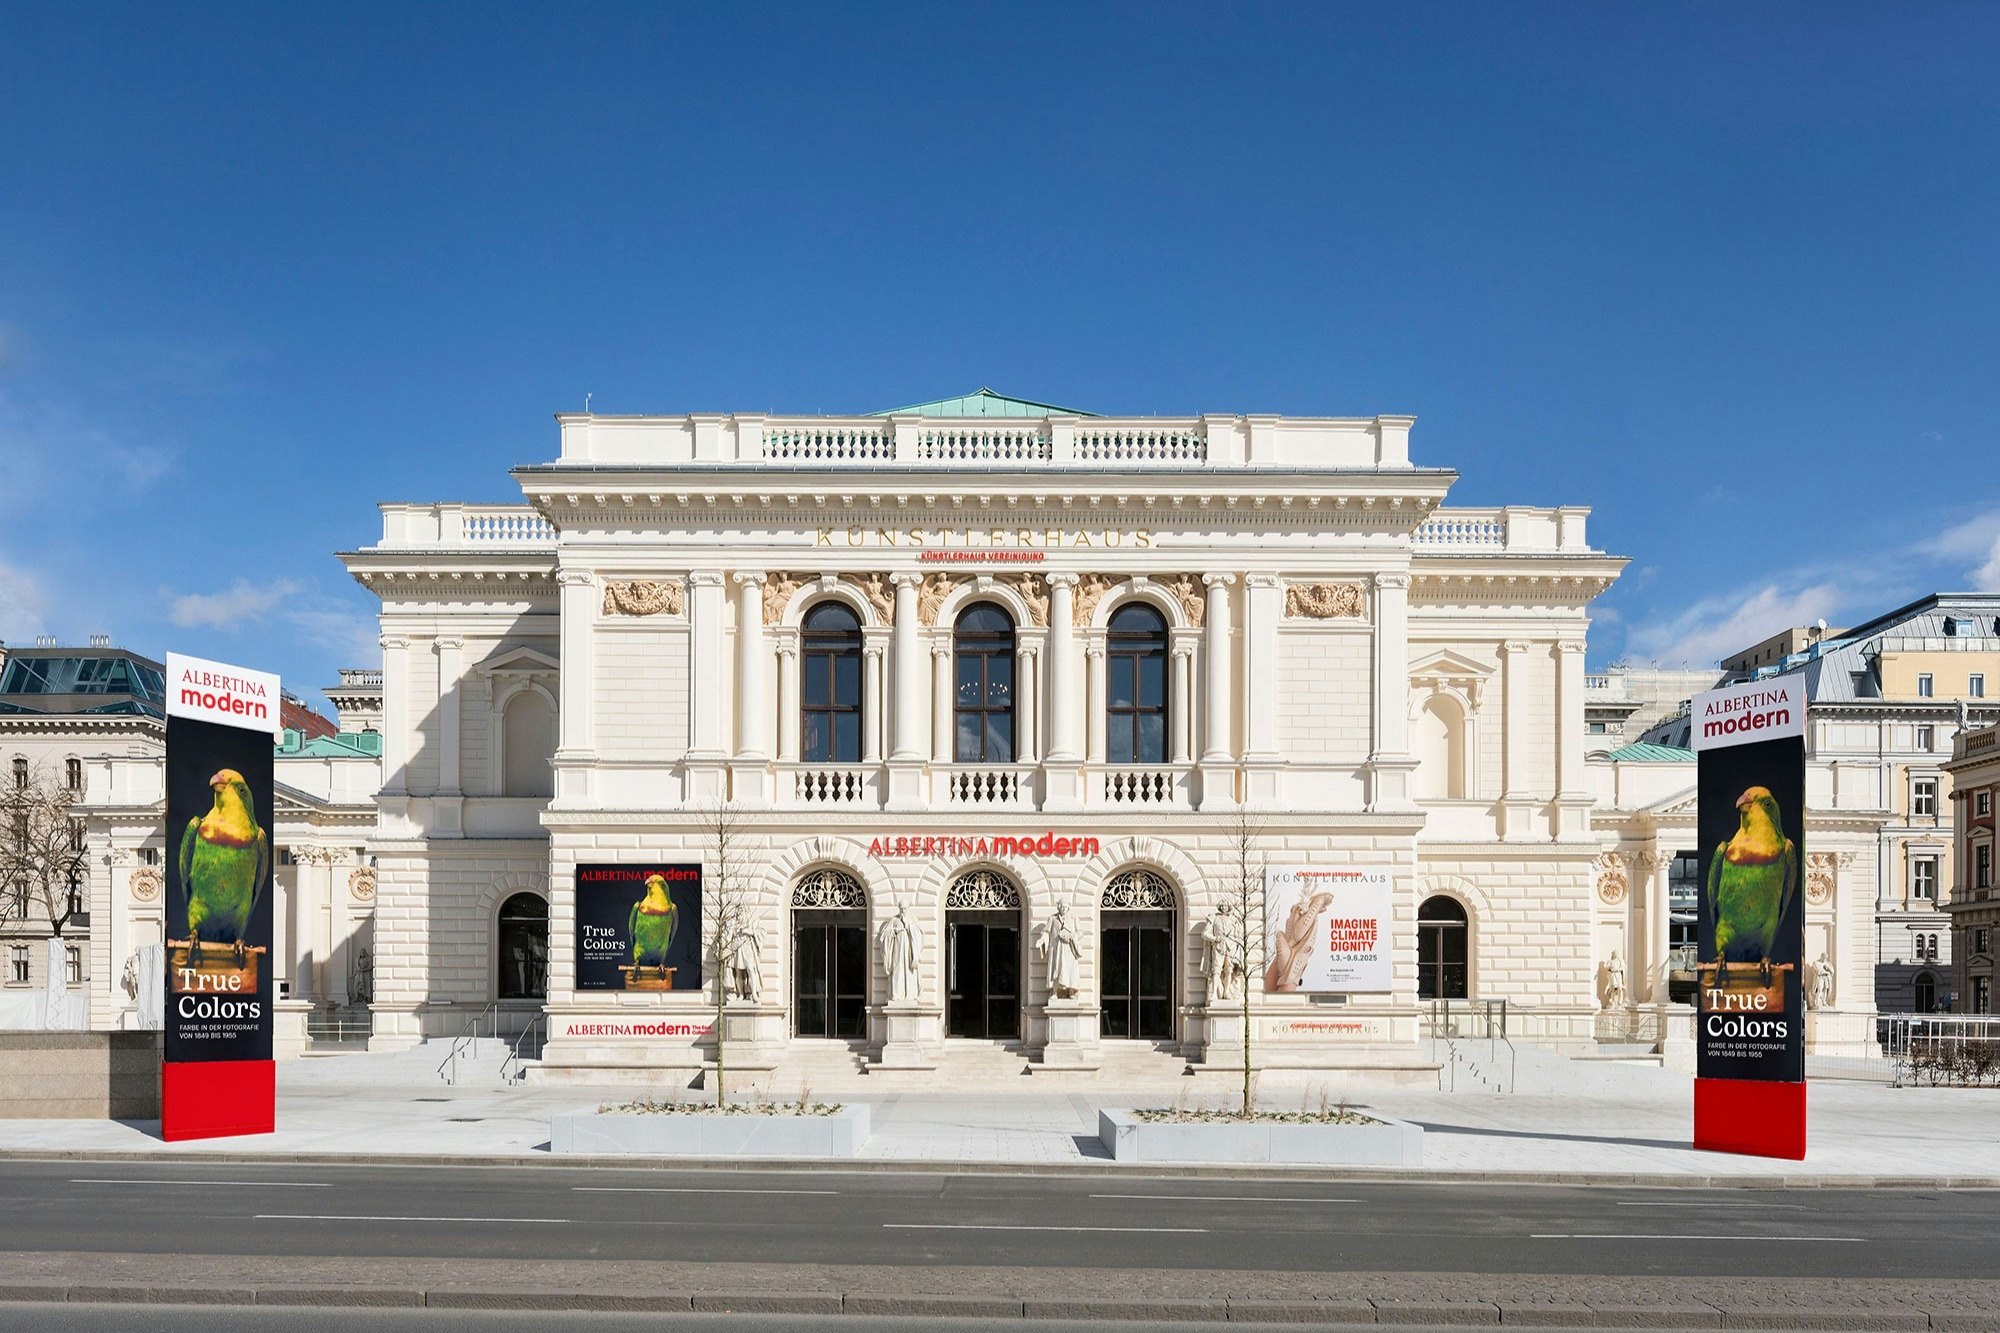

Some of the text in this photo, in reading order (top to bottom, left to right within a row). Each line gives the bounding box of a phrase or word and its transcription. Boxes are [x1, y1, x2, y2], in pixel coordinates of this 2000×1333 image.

[815, 525, 1152, 548] KÜNSTLERHAUS
[921, 550, 1044, 561] KÜNSTLERHAUS VEREINIGUNG
[182, 669, 266, 698] ALBERTINA
[181, 688, 267, 718] modern
[1705, 689, 1789, 716] ALBERTINA
[1704, 708, 1790, 738] modern
[868, 832, 1099, 856] ALBERTINA modern
[581, 871, 641, 880] ALBERTINA
[583, 925, 616, 937] True
[1330, 919, 1377, 929] IMAGINE
[583, 939, 626, 950] Colors
[1330, 930, 1378, 941] CLIMATE
[1330, 941, 1375, 952] DIGNITY
[178, 968, 241, 991] True
[178, 996, 261, 1018] Colors
[1706, 989, 1767, 1010] True
[567, 1022, 691, 1035] ALBERTINA modern
[1707, 1015, 1788, 1038] Colors
